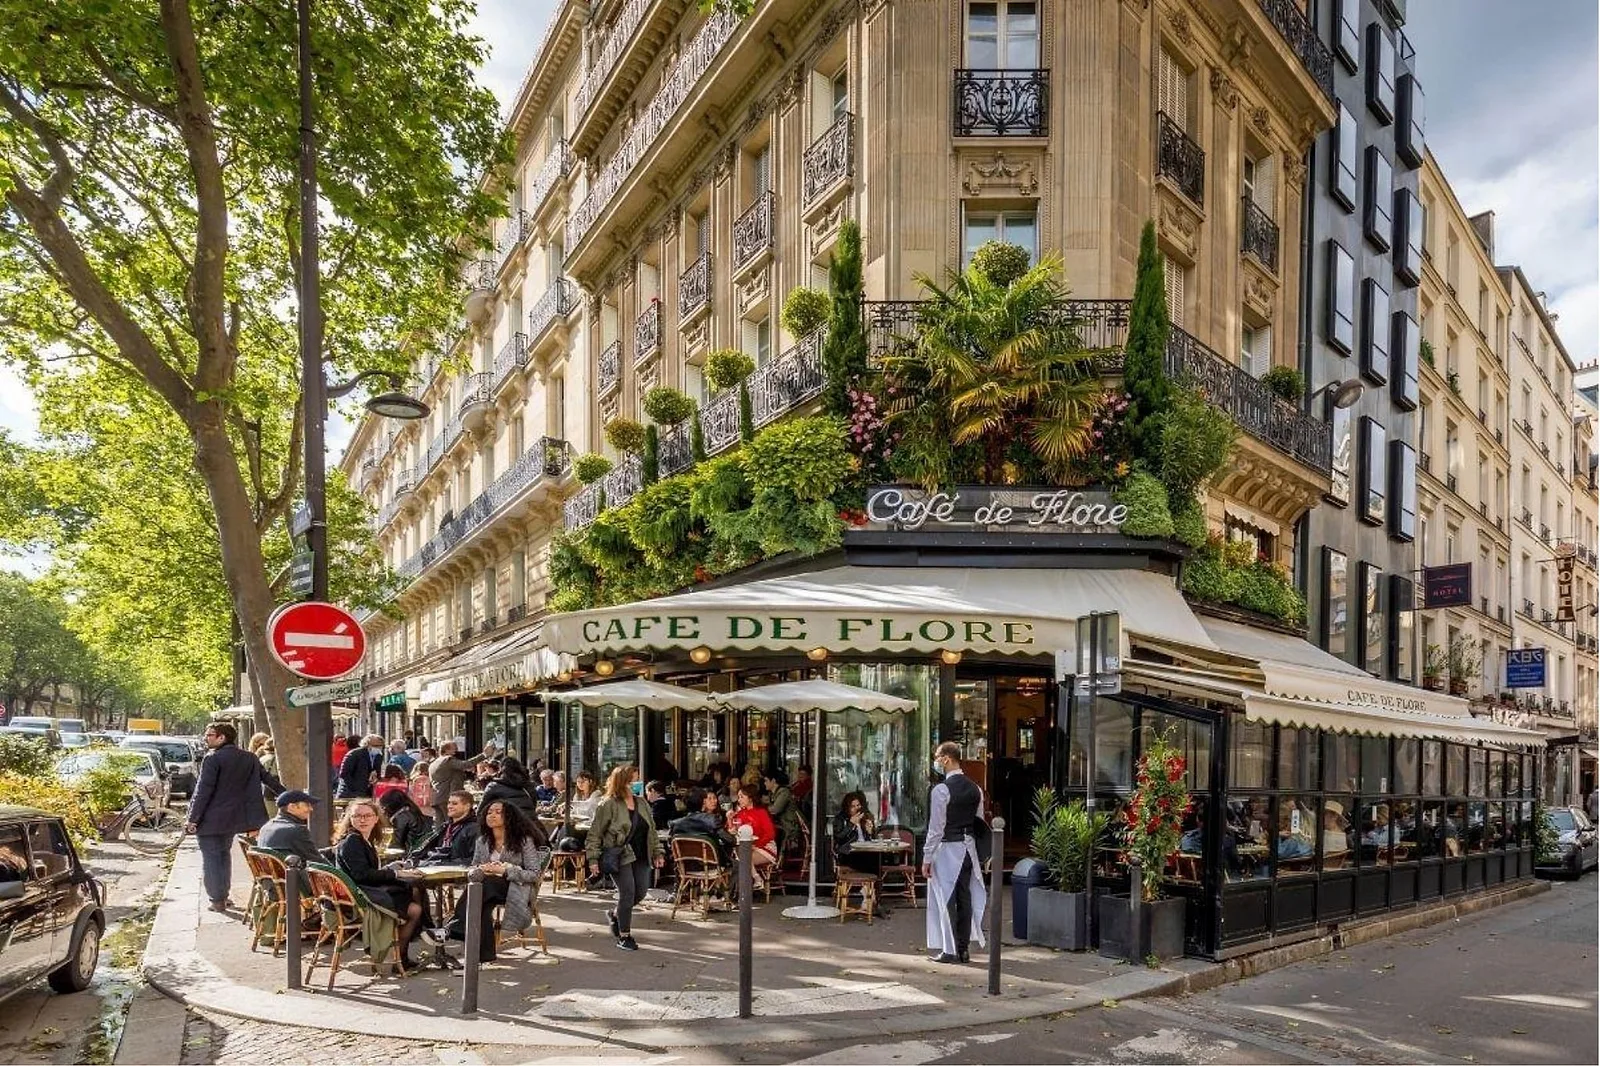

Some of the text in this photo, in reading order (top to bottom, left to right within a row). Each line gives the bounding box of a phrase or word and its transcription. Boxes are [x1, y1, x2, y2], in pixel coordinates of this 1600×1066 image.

[867, 489, 1128, 530] Café de Flore
[582, 616, 1034, 644] CAFE DE FLORE
[1347, 690, 1427, 712] CAFE DE FLORE
